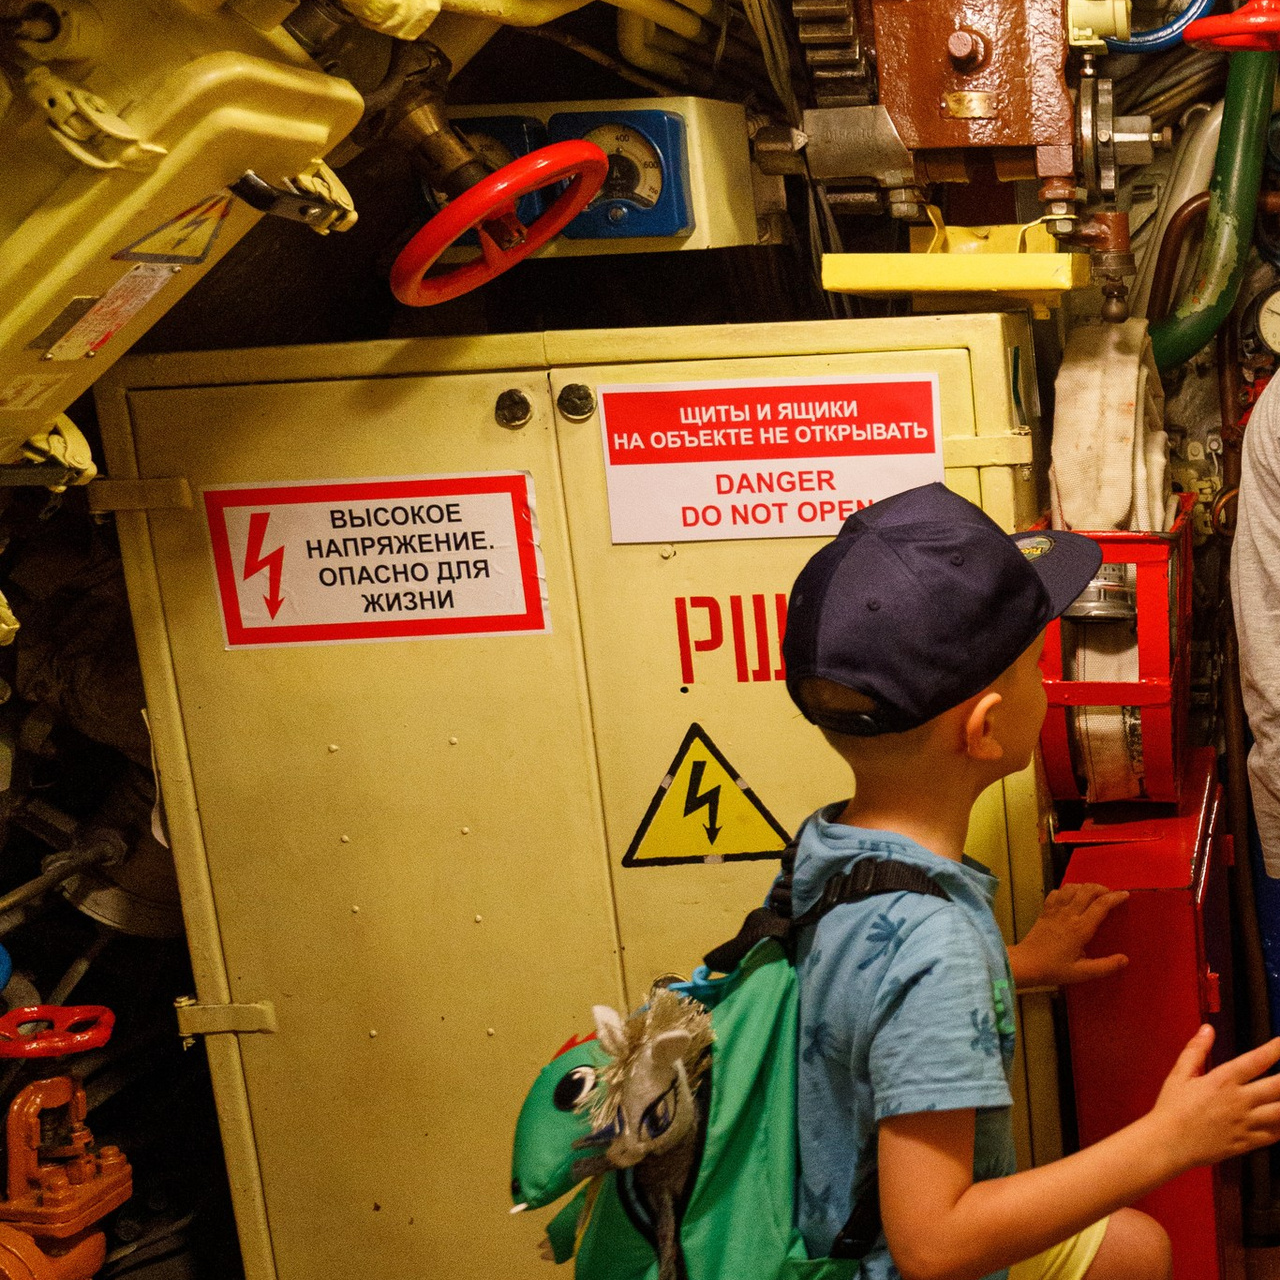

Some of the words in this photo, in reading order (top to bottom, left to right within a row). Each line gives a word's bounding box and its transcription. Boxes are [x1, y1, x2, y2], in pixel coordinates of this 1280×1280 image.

[679, 404, 750, 426] ЩИТЫ
[757, 403, 772, 421] И
[777, 400, 858, 421] ЯЩИКИ
[613, 433, 646, 450] НА
[650, 428, 754, 449] ОБЪЕКТЕ
[760, 426, 789, 445] НЕ
[794, 422, 928, 443] ОТКРЫВАТЬ
[715, 470, 836, 495] DANGER
[329, 503, 462, 529] ВЫСОКОЕ
[681, 505, 723, 527] DO
[731, 502, 788, 525] NOT
[305, 530, 495, 560] НАПРЯЖЕНИЕ.
[318, 562, 430, 587] ОПАСНО
[436, 559, 490, 583] ДЛЯ
[362, 589, 455, 613] ЖИЗНИ
